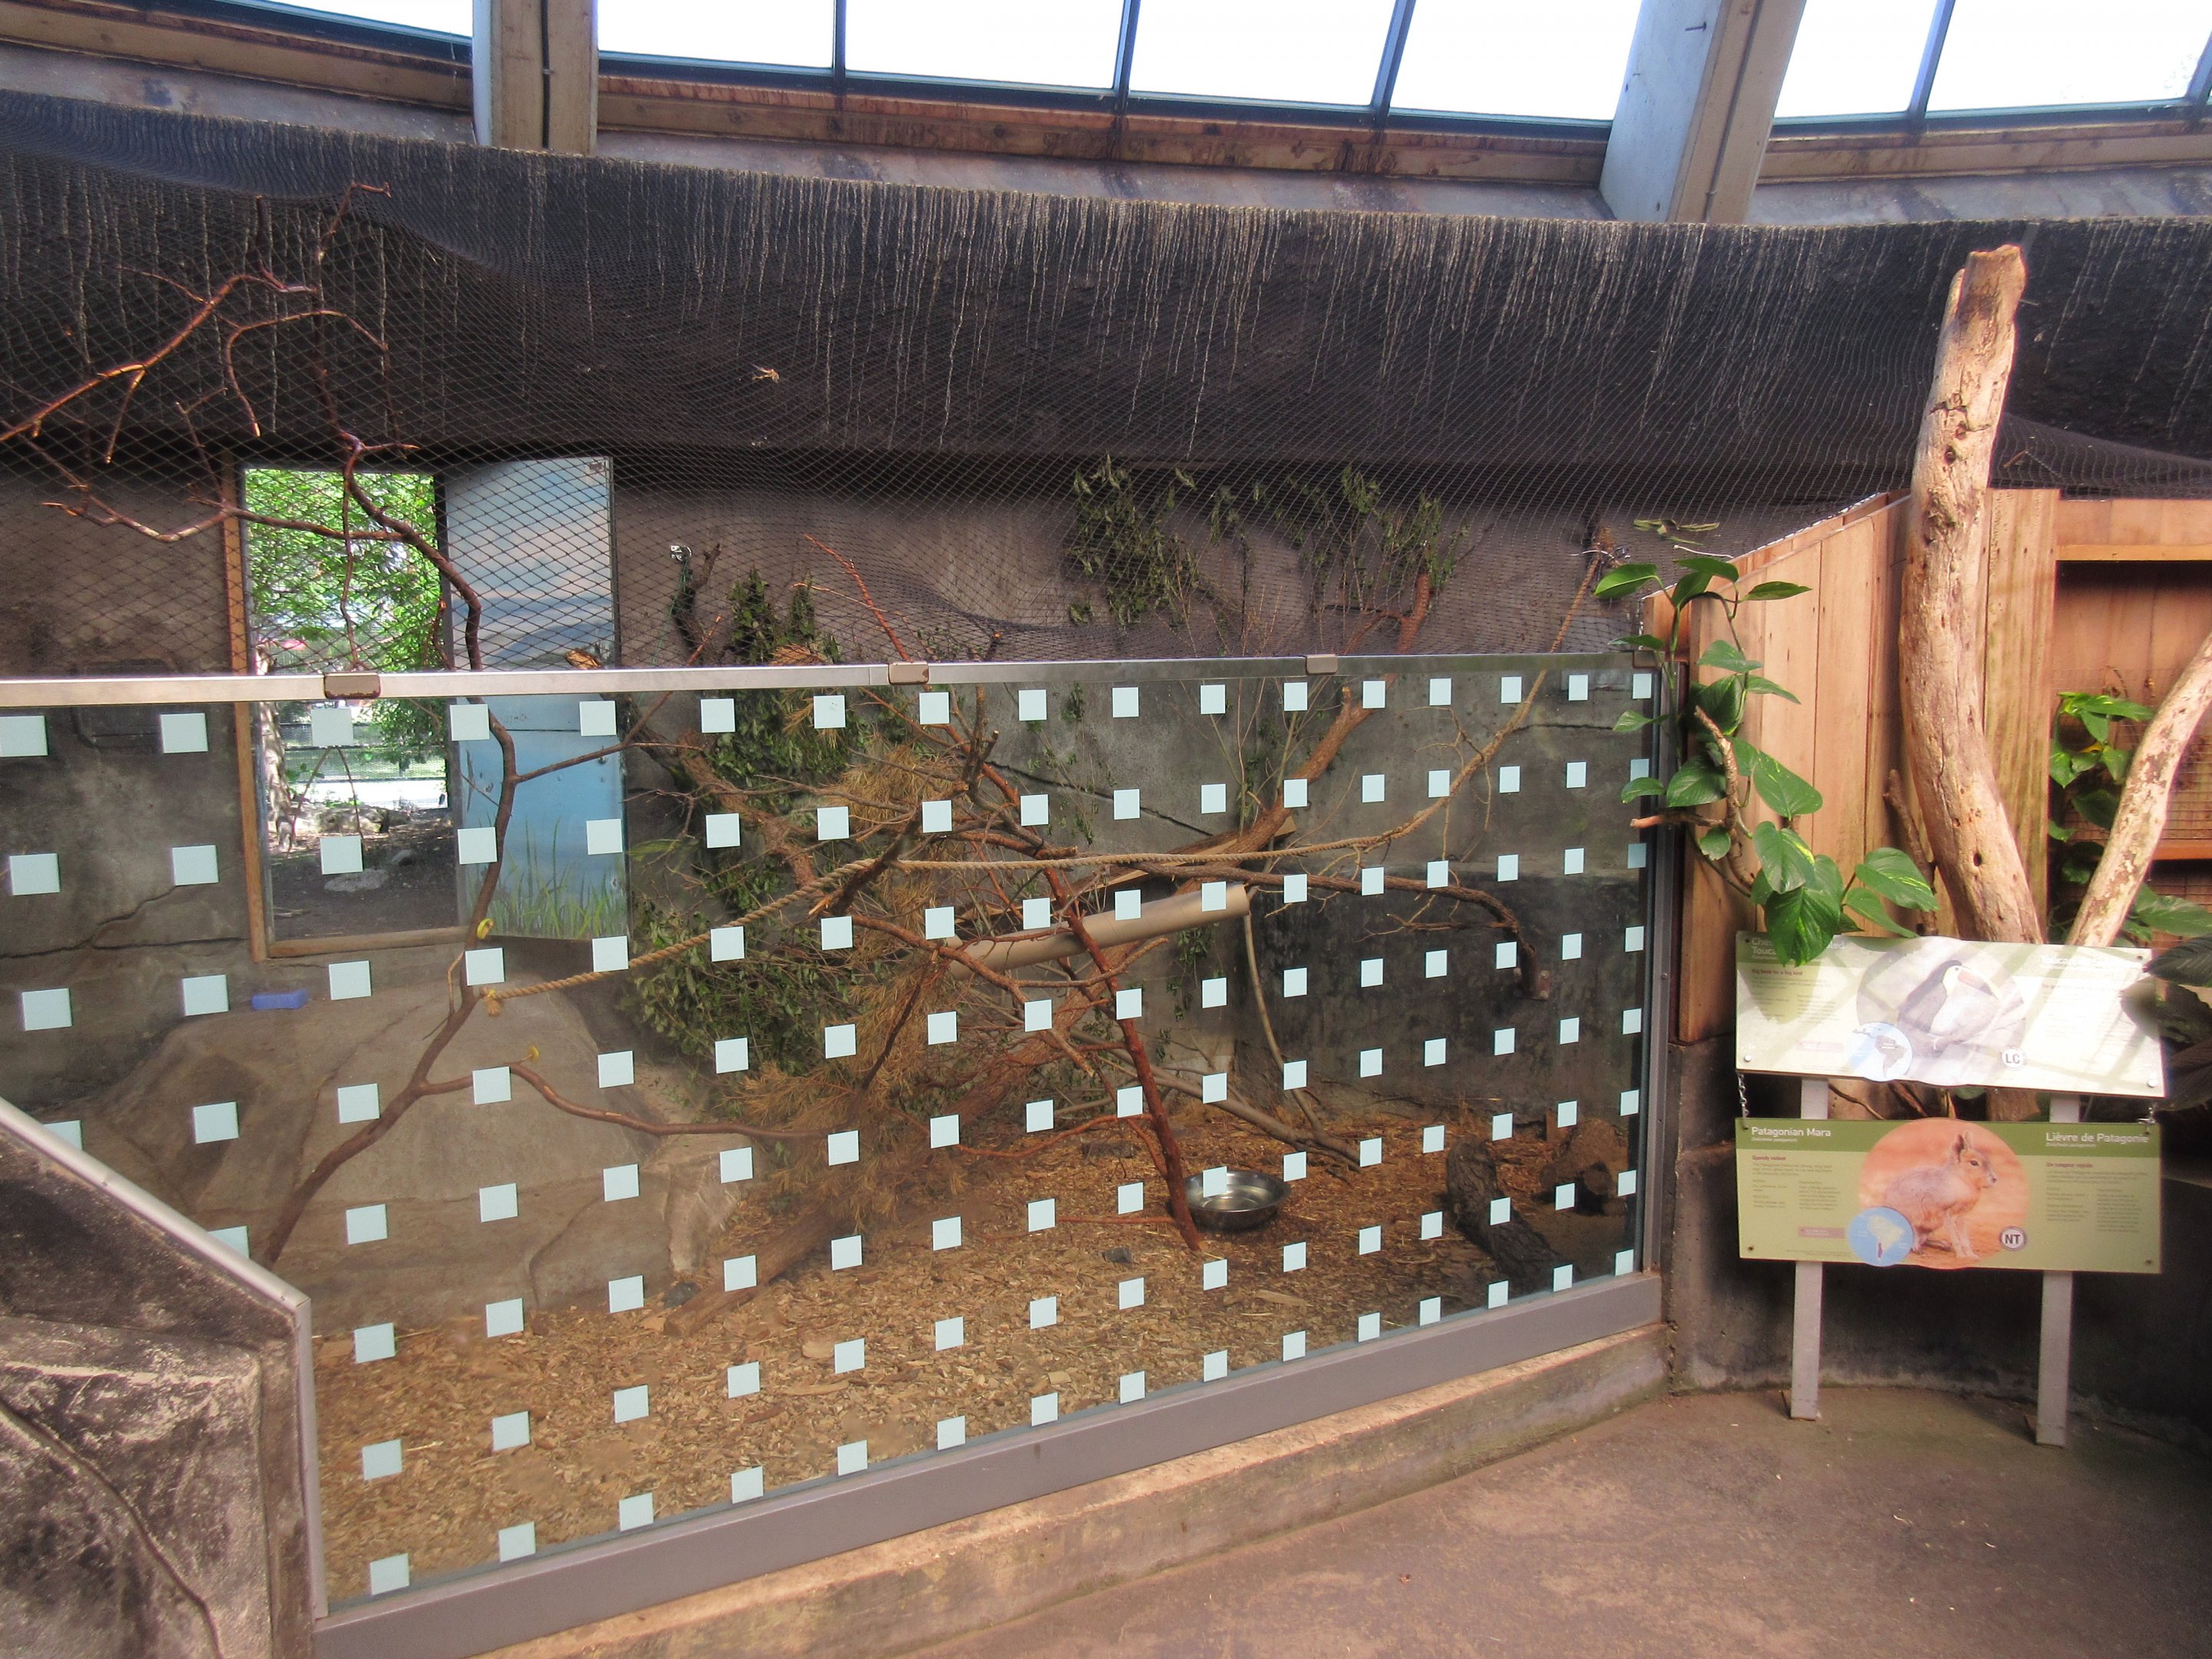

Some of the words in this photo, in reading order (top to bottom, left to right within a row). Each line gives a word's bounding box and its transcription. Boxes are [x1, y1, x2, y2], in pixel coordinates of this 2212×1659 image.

[2005, 1053, 2020, 1064] LC
[1751, 1127, 1804, 1137] Patagonian
[1806, 1128, 1831, 1137] Mara
[2046, 1132, 2078, 1141] Lièvre
[2081, 1133, 2094, 1142] de
[2097, 1134, 2149, 1144] Patagonie
[2005, 1234, 2020, 1244] NT
